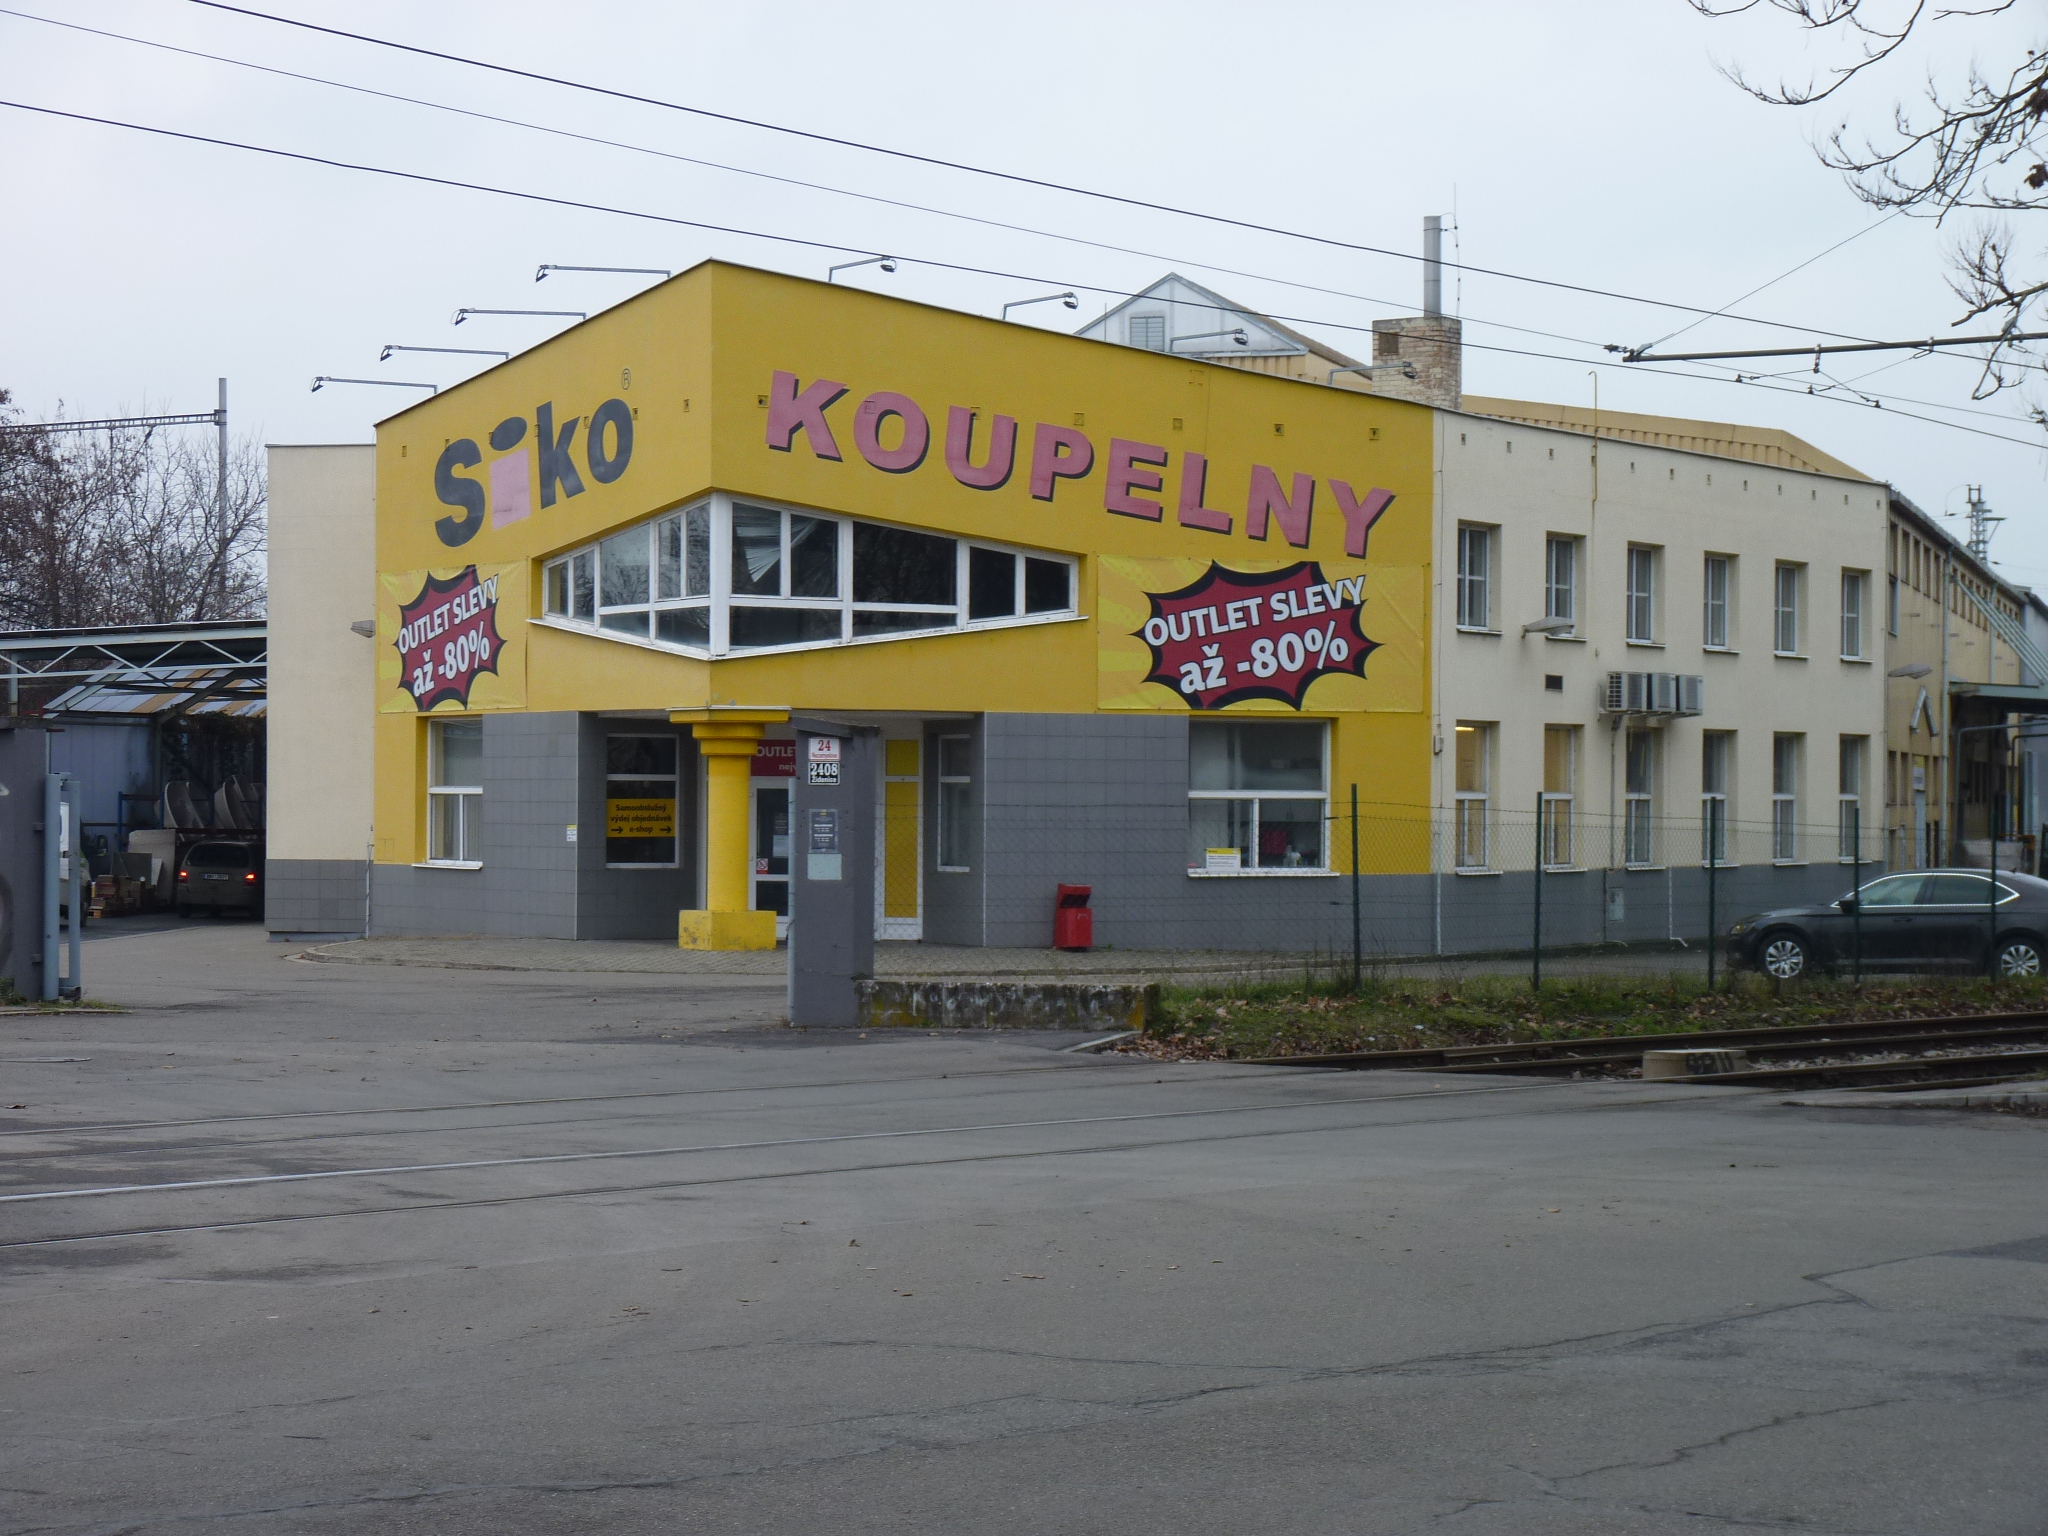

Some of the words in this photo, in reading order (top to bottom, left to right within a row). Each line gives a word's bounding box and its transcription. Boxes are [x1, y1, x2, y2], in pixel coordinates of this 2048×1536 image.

[765, 370, 1395, 559] KOUPELNY
[398, 603, 450, 654] OUTLET
[453, 573, 499, 625] SLEVY
[1144, 596, 1263, 647] OUTLET
[1270, 575, 1366, 622] SLEVY
[413, 649, 435, 697] až
[438, 620, 490, 680] -80%
[1179, 643, 1227, 694] až
[1236, 619, 1349, 678] -80%
[810, 763, 838, 776] 2408
[818, 740, 831, 751] 24
[629, 825, 654, 834] e-shop
